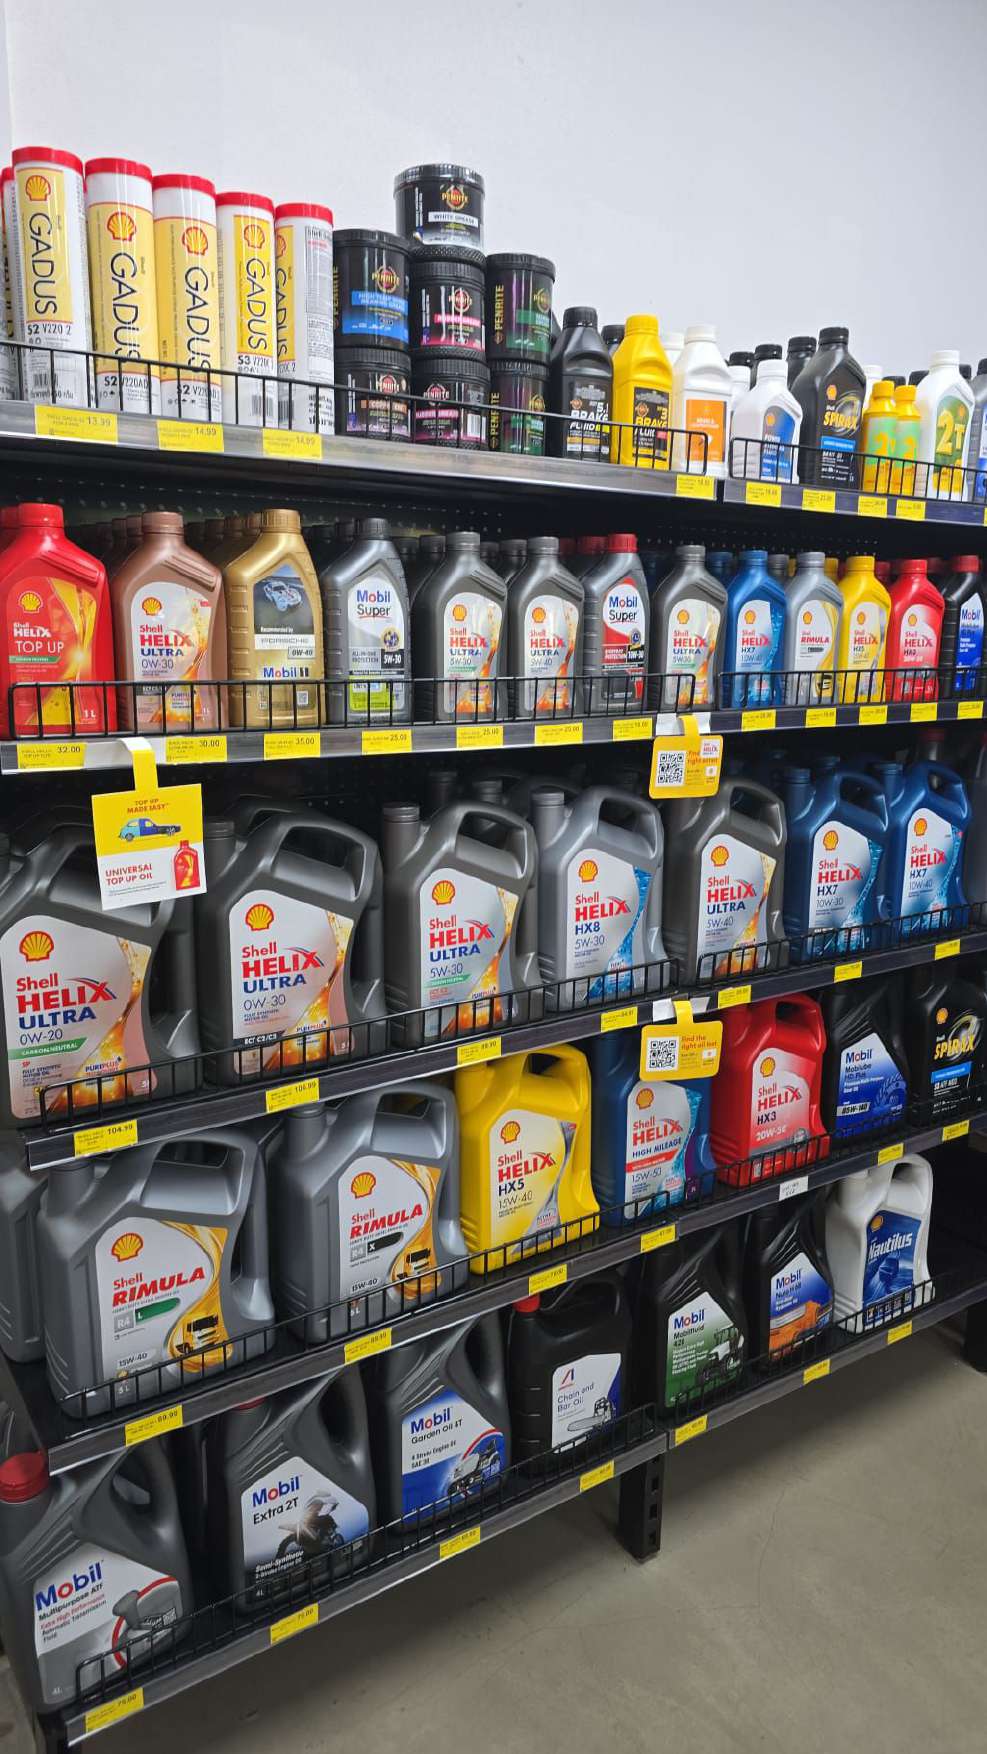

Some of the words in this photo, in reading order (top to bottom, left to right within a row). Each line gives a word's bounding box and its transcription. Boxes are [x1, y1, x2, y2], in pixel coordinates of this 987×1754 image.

[29, 212, 58, 315] GADUS
[110, 252, 141, 363] GADUS
[246, 258, 268, 351] GADUS
[494, 284, 504, 330] PENRITE
[185, 266, 212, 373] GADUS
[27, 324, 40, 335] S2
[238, 355, 251, 366] S3
[104, 376, 118, 387] S2
[570, 410, 609, 422] BRAKE
[636, 416, 668, 428] BRAKE
[824, 412, 858, 430] SPIRAX
[936, 410, 966, 456] 2T
[356, 590, 391, 603] Mobil
[609, 596, 638, 608] Mobil
[357, 604, 391, 617] Super
[609, 610, 638, 623] Super
[962, 609, 981, 621] Mobil
[14, 626, 52, 638] HELIX
[140, 624, 163, 633] Shell
[450, 628, 467, 636] Shell
[530, 629, 546, 637] Shell
[140, 631, 194, 647] HELIX
[450, 634, 488, 648] HELIX
[530, 635, 566, 648] HELIX
[673, 636, 708, 648] HELIX
[741, 635, 770, 646] HELIX
[801, 636, 830, 644] RIMULA
[854, 634, 878, 645] HELIX
[904, 636, 933, 648] HELIX
[16, 640, 43, 654] TOP
[48, 640, 65, 654] UP
[140, 648, 184, 657] ULTRA
[142, 658, 174, 670] 0W-30
[263, 667, 297, 678] Mobil
[57, 745, 81, 754] 32.00
[295, 738, 315, 746] 35.00
[127, 806, 148, 814] MADE
[149, 804, 166, 812] EASY
[911, 845, 928, 854] Shell
[819, 858, 838, 870] Shell
[910, 849, 947, 868] HELIX
[106, 864, 153, 878] UNIVERSAL
[818, 864, 862, 884] HELIX
[910, 868, 927, 879] HX7
[107, 877, 124, 886] TOP
[708, 876, 730, 888] Shell
[909, 881, 933, 890] 10W-40
[708, 880, 756, 903] HELIX
[817, 884, 838, 896] HX7
[576, 892, 599, 905] Shell
[816, 896, 843, 908] 10W-30
[575, 899, 630, 922] HELIX
[707, 902, 746, 915] ULTRA
[430, 915, 457, 930] Shell
[575, 922, 600, 936] HX8
[706, 916, 733, 929] 5W-40
[430, 922, 495, 949] HELIX
[576, 935, 605, 950] 5W-30
[242, 942, 277, 959] Shell
[430, 944, 481, 963] ULTRA
[242, 950, 322, 979] HELIX
[430, 962, 464, 979] 5W-30
[16, 973, 59, 992] Shell
[243, 974, 307, 994] ULTRA
[16, 978, 115, 1014] HELIX
[244, 994, 286, 1011] 0W-30
[18, 1006, 96, 1030] ULTRA
[20, 1029, 63, 1046] 0W-20
[245, 1037, 256, 1045] ECT
[21, 1047, 50, 1056] CARBON
[50, 1042, 78, 1053] NEUTRAL
[934, 1034, 975, 1060] SPIRAX
[846, 1049, 873, 1064] Mobil
[758, 1082, 777, 1097] Shell
[758, 1086, 802, 1112] HELIX
[633, 1116, 655, 1131] Shell
[757, 1112, 776, 1126] HX3
[633, 1118, 682, 1146] HELIX
[633, 1148, 652, 1159] HIGH
[654, 1137, 682, 1154] MILEAGE
[498, 1150, 523, 1167] Shell
[498, 1152, 555, 1183] HELIX
[498, 1182, 525, 1197] HX5
[498, 1190, 533, 1210] 15W-40
[350, 1204, 423, 1240] RIMULA
[352, 1209, 375, 1225] Shell
[369, 1242, 376, 1251] X
[868, 1232, 913, 1259] Nautilus
[112, 1266, 205, 1308] RIMULA
[113, 1273, 143, 1290] Shell
[352, 1278, 378, 1292] 15W-40
[776, 1270, 802, 1290] Mobil
[776, 1290, 790, 1299] Nuto
[118, 1318, 131, 1328] R4
[138, 1312, 143, 1320] L
[674, 1309, 705, 1330] Mobil
[673, 1325, 704, 1340] Mobilfluid
[118, 1353, 148, 1368] 15W-40
[558, 1391, 580, 1404] Chain
[582, 1383, 595, 1393] and
[558, 1402, 571, 1413] Bar
[573, 1397, 584, 1407] Oil
[411, 1407, 451, 1435] Mobil
[412, 1428, 441, 1445] Garden
[443, 1424, 453, 1432] Oil
[252, 1476, 300, 1508] Mobil
[253, 1504, 284, 1525] Extra
[286, 1497, 299, 1512] 2T
[36, 1562, 103, 1612] Mobil
[38, 1592, 89, 1621] Multipurpose
[91, 1584, 104, 1595] ATF
[41, 1619, 56, 1630] Extra
[56, 1611, 70, 1624] High
[72, 1594, 105, 1616] Performance
[42, 1620, 71, 1636] Automatic
[72, 1601, 107, 1620] Transmission
[43, 1633, 58, 1643] Fluid
